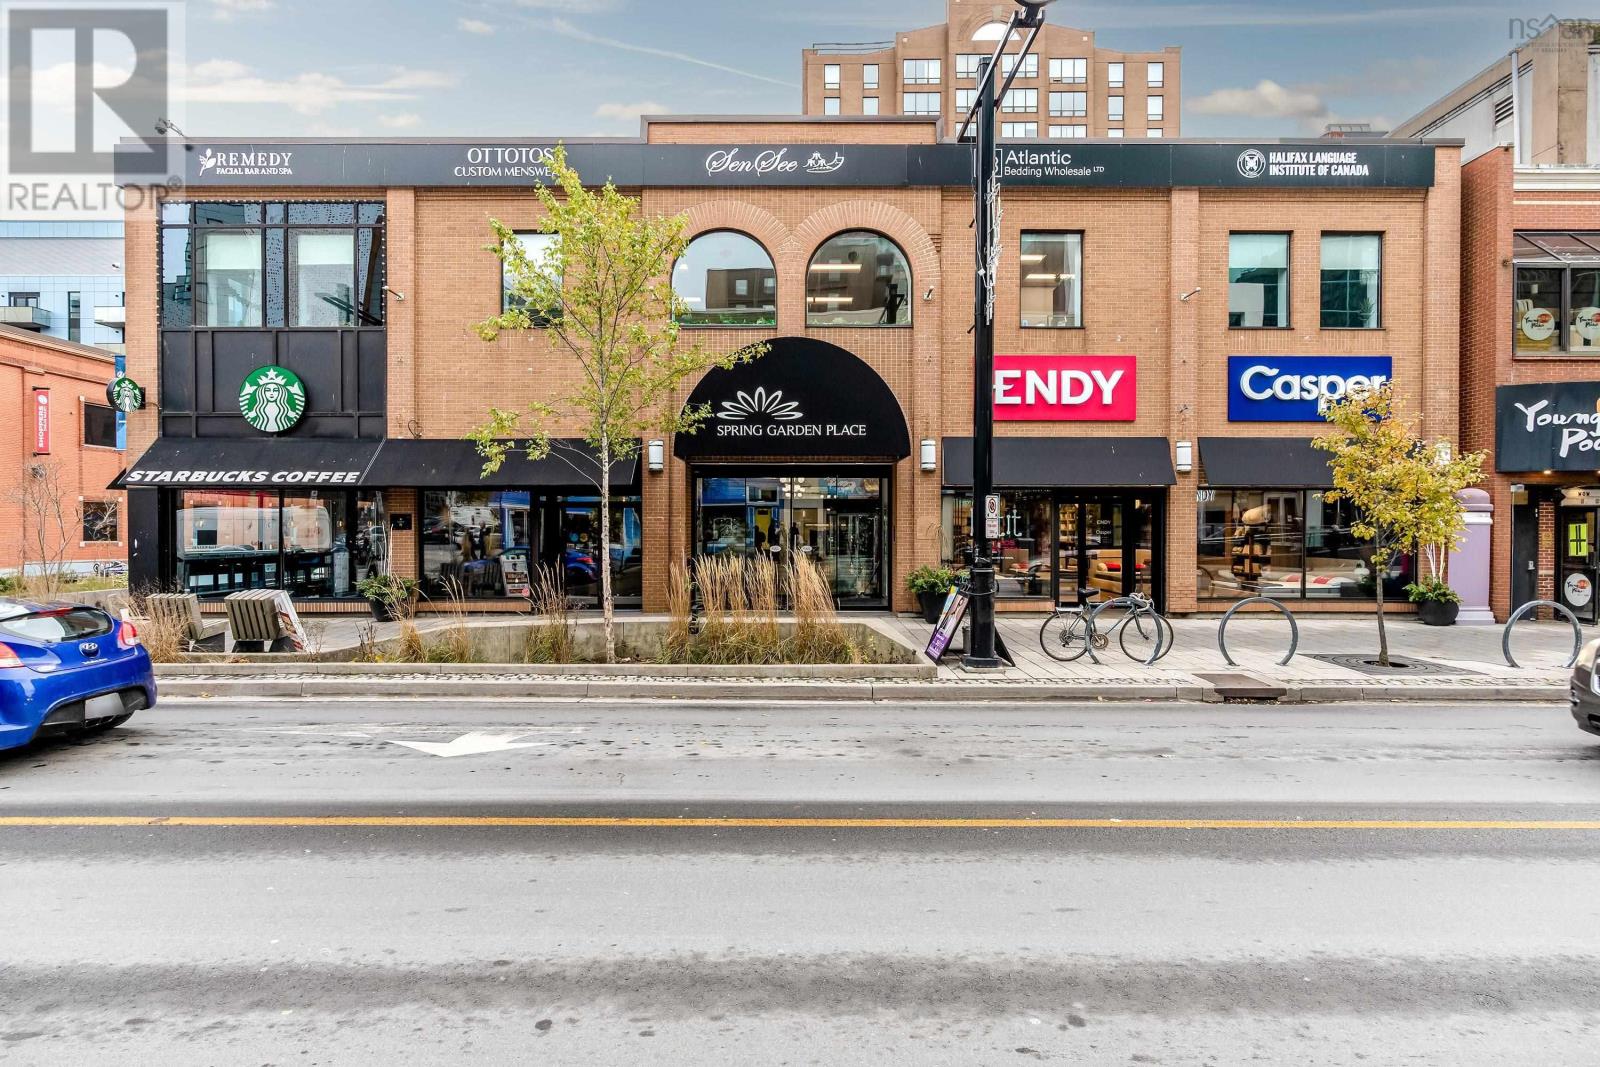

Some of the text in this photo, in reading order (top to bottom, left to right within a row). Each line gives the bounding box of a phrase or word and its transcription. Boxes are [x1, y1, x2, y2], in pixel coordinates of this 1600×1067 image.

[216, 152, 293, 166] REMEDY
[467, 147, 555, 163] OTTOTOS
[1004, 149, 1072, 165] Atlantic
[1269, 152, 1357, 163] HALIFAX LANGUAGE
[216, 167, 293, 175] FACIAL BAR AND SPA
[454, 166, 560, 177] CUSTOM MENSWEA
[1004, 166, 1042, 177] Bedding
[1044, 166, 1092, 176] Wholesale
[1269, 164, 1369, 176] INSTITUTE OF CANADA
[993, 370, 1124, 405] ENDY
[1240, 365, 1386, 413] Casper
[1514, 399, 1600, 437] Young
[717, 424, 867, 436] SPRING GARDEN PLACE
[126, 470, 361, 483] STARBUCKS COFFEE
[1196, 490, 1215, 501] NDY
